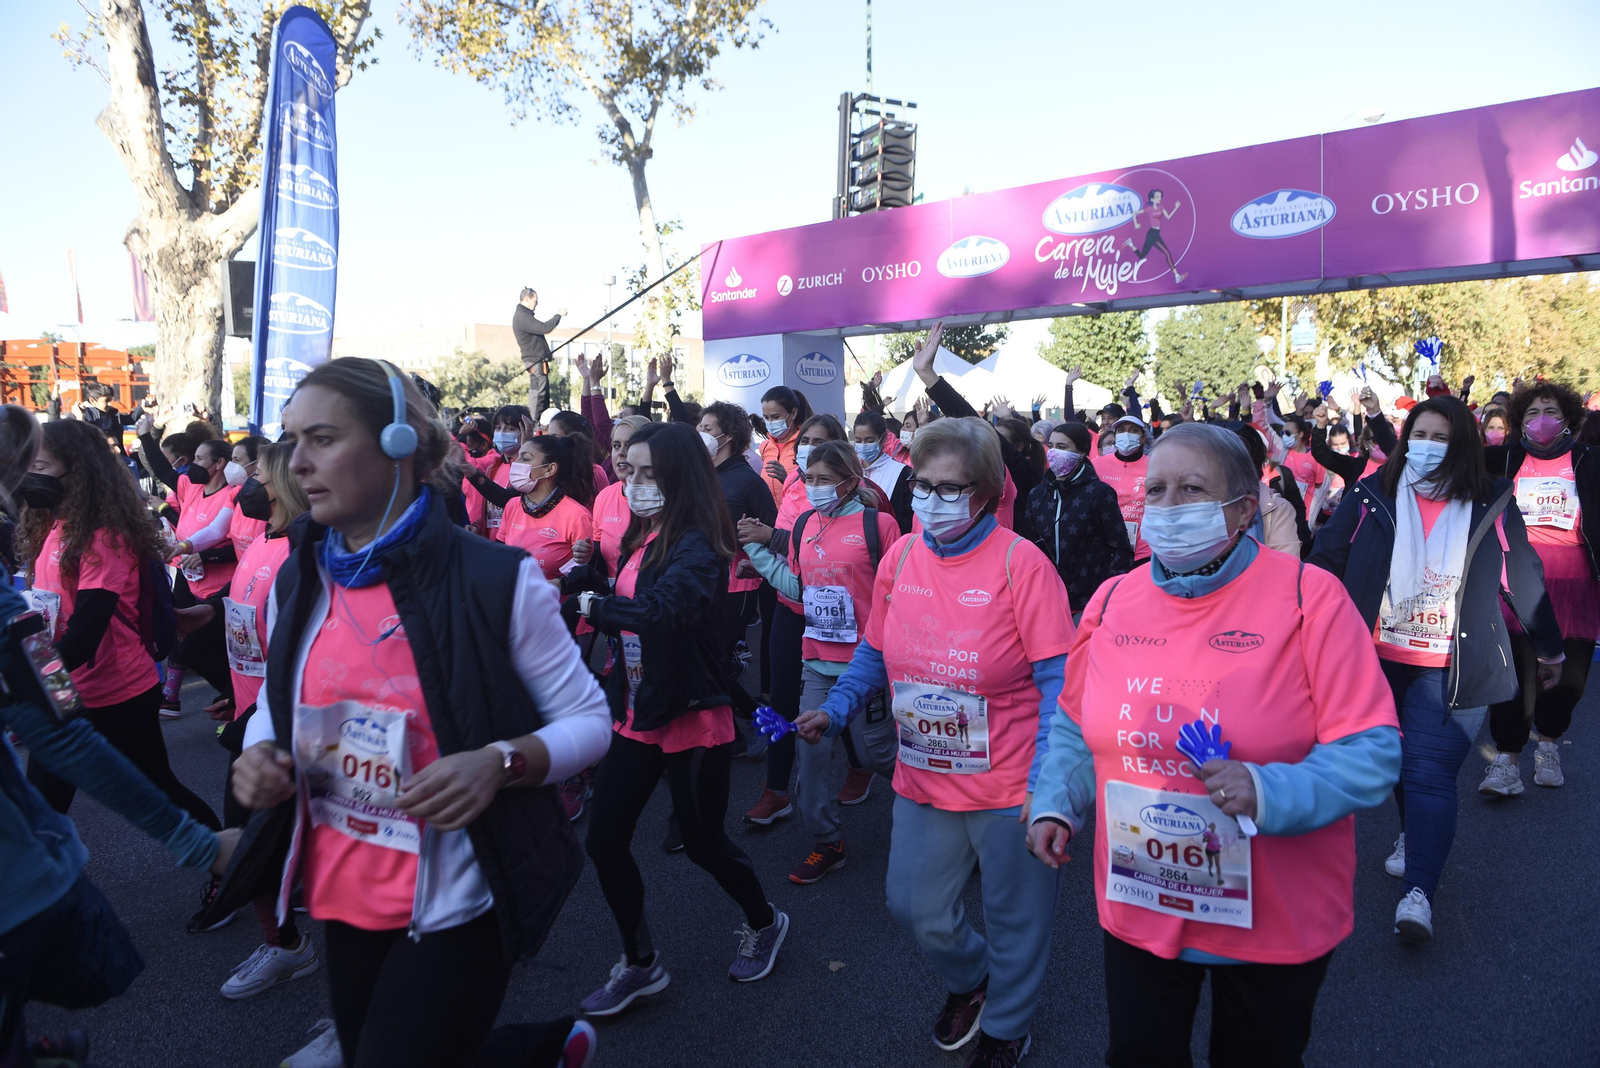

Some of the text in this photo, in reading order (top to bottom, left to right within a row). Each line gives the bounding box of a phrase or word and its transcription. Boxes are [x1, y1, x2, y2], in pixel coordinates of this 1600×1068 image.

[278, 177, 336, 206] STURIANA
[1519, 175, 1600, 199] Santan
[1371, 182, 1480, 215] OYSHO
[1051, 202, 1134, 226] ASTURIANA
[1239, 207, 1328, 230] ASTURIANA
[274, 244, 334, 267] STURIANA
[1035, 235, 1115, 263] Carrera
[943, 253, 1003, 270] ASTURIANA
[861, 261, 921, 283] OYSHO
[1054, 250, 1148, 295] de la Mujer
[798, 273, 843, 290] ZURICH
[711, 288, 757, 303] Santander
[269, 309, 328, 329] STURIANA
[721, 368, 767, 381] ASTURIANA
[799, 362, 835, 378] ASTURIANA
[1536, 495, 1560, 506] 016
[898, 583, 933, 598] OYSHO
[961, 593, 989, 603] ASTURIANA
[815, 606, 839, 617] 016
[1411, 625, 1428, 633] 2023
[1115, 634, 1166, 647] OYSHO
[1213, 637, 1261, 648] ASTURIANA
[948, 649, 979, 663] POR
[930, 662, 977, 680] TODAS
[1127, 678, 1163, 694] WE
[917, 700, 956, 712] ASTURIANA
[918, 719, 957, 737] 016
[927, 738, 948, 749] 2863
[1117, 730, 1163, 750] FOR
[901, 751, 925, 764] OYSHO
[911, 744, 933, 753] CARRERA
[942, 748, 949, 756] LA
[951, 749, 970, 757] MUJER
[343, 754, 392, 789] 016
[1122, 756, 1193, 777] REASO
[1145, 811, 1202, 832] ASTURIANA
[1146, 838, 1204, 868] 016
[1159, 867, 1189, 882] 2864
[1113, 883, 1154, 901] OYSHO
[1134, 872, 1224, 898] CARRERA DE LA MUJER
[1213, 906, 1243, 916] ZURICH
